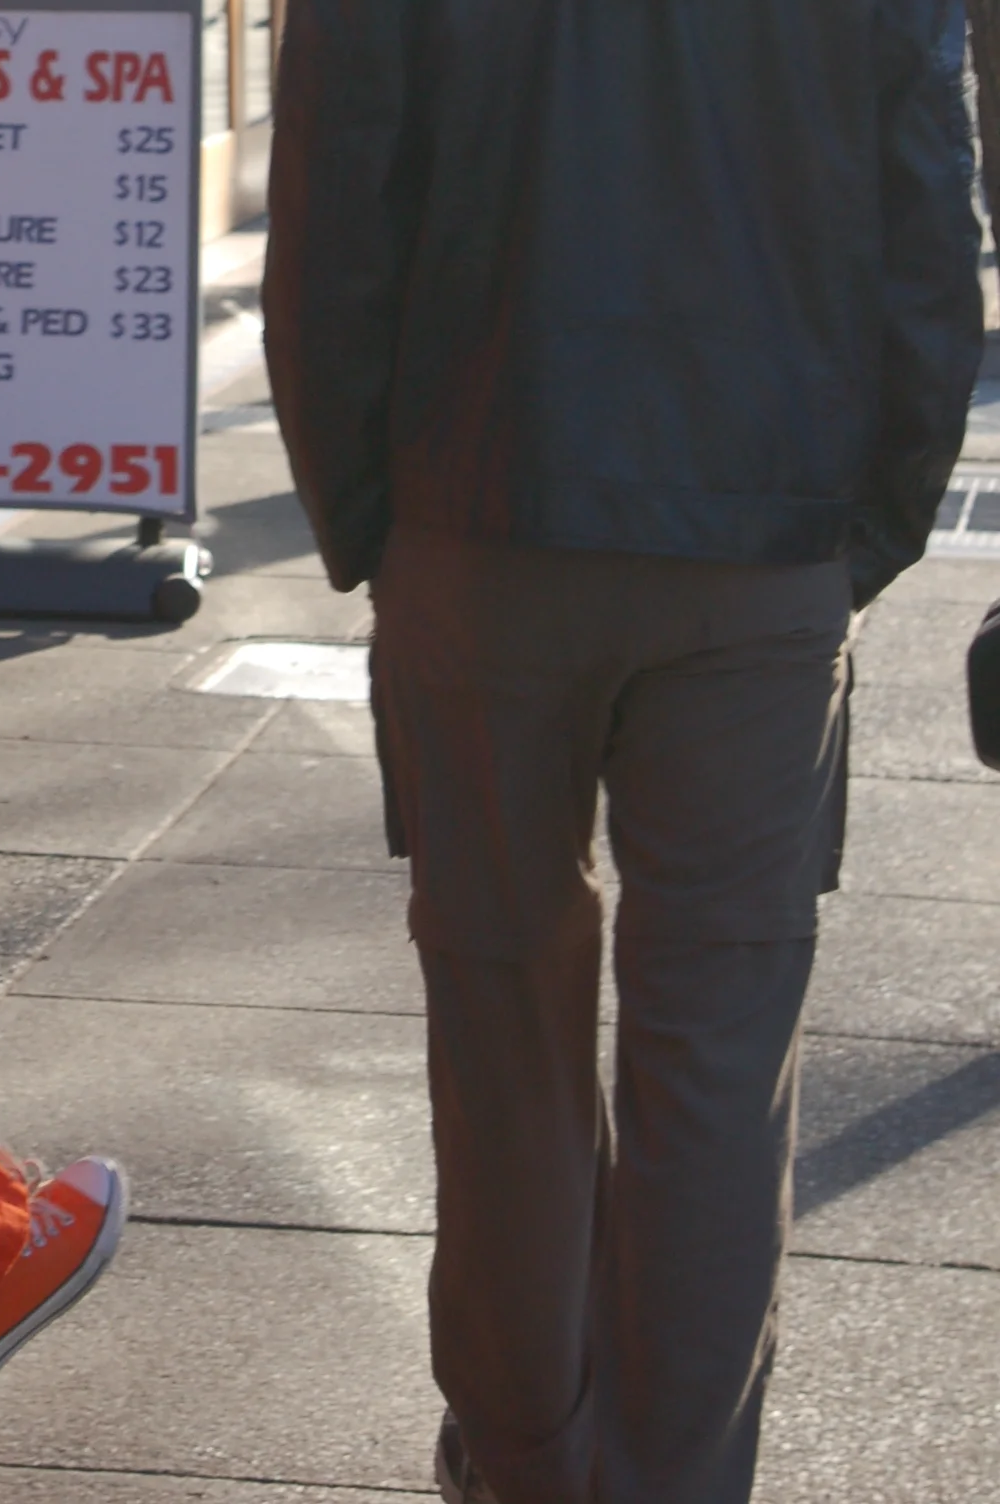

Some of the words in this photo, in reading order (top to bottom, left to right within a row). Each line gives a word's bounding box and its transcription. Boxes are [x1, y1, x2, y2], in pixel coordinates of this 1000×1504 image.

[30, 49, 65, 102] &
[83, 50, 175, 104] SPA
[118, 126, 175, 155] $25
[115, 174, 168, 203] $15
[114, 220, 165, 249] $12
[115, 265, 173, 295] $23
[21, 308, 89, 337] PED
